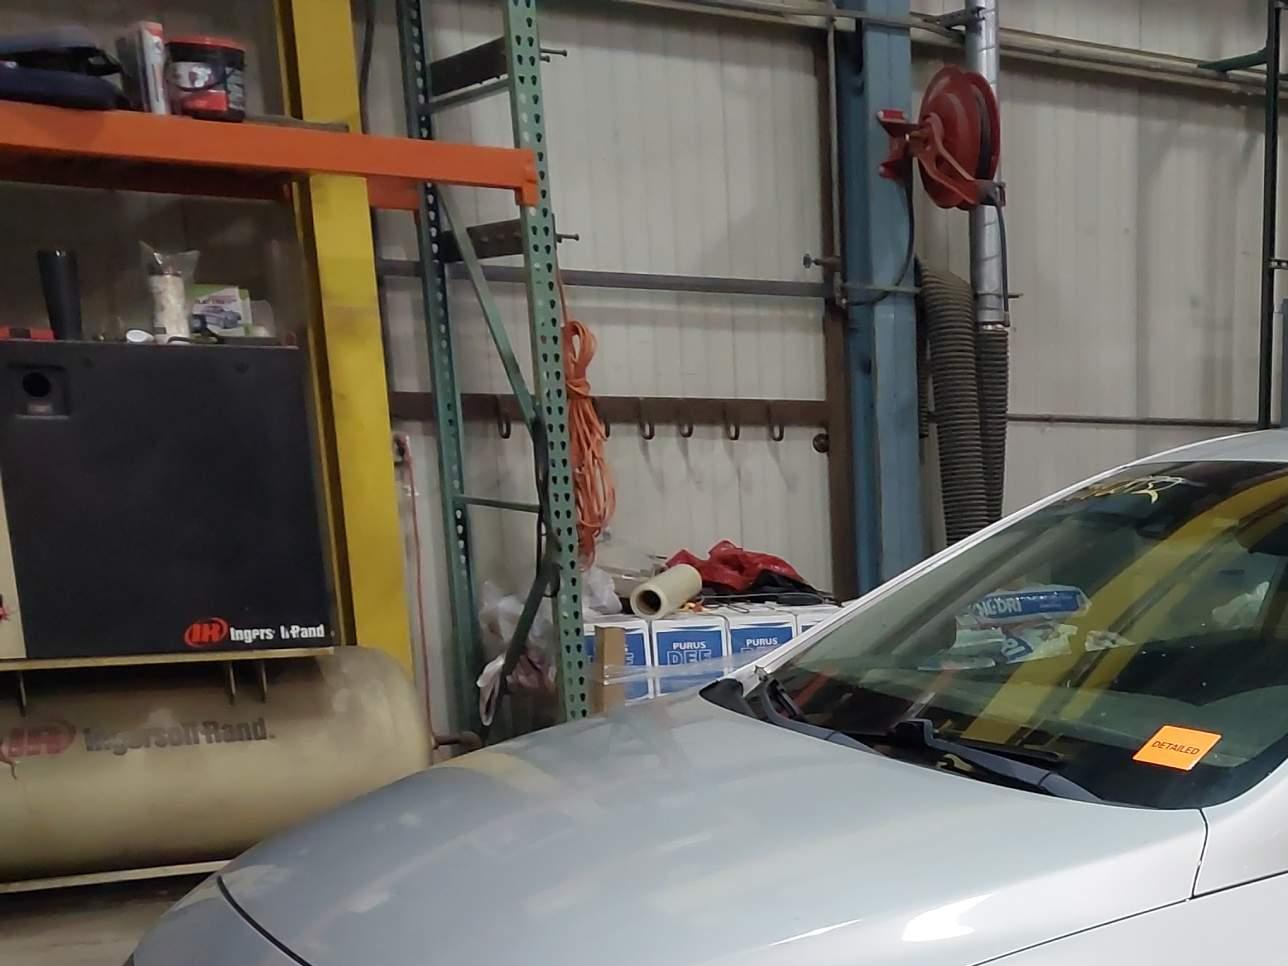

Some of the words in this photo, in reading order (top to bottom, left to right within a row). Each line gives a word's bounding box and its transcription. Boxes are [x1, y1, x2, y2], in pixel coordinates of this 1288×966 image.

[672, 640, 707, 650] PURUS
[745, 637, 779, 647] PURUS
[1151, 740, 1201, 755] DETAILED
